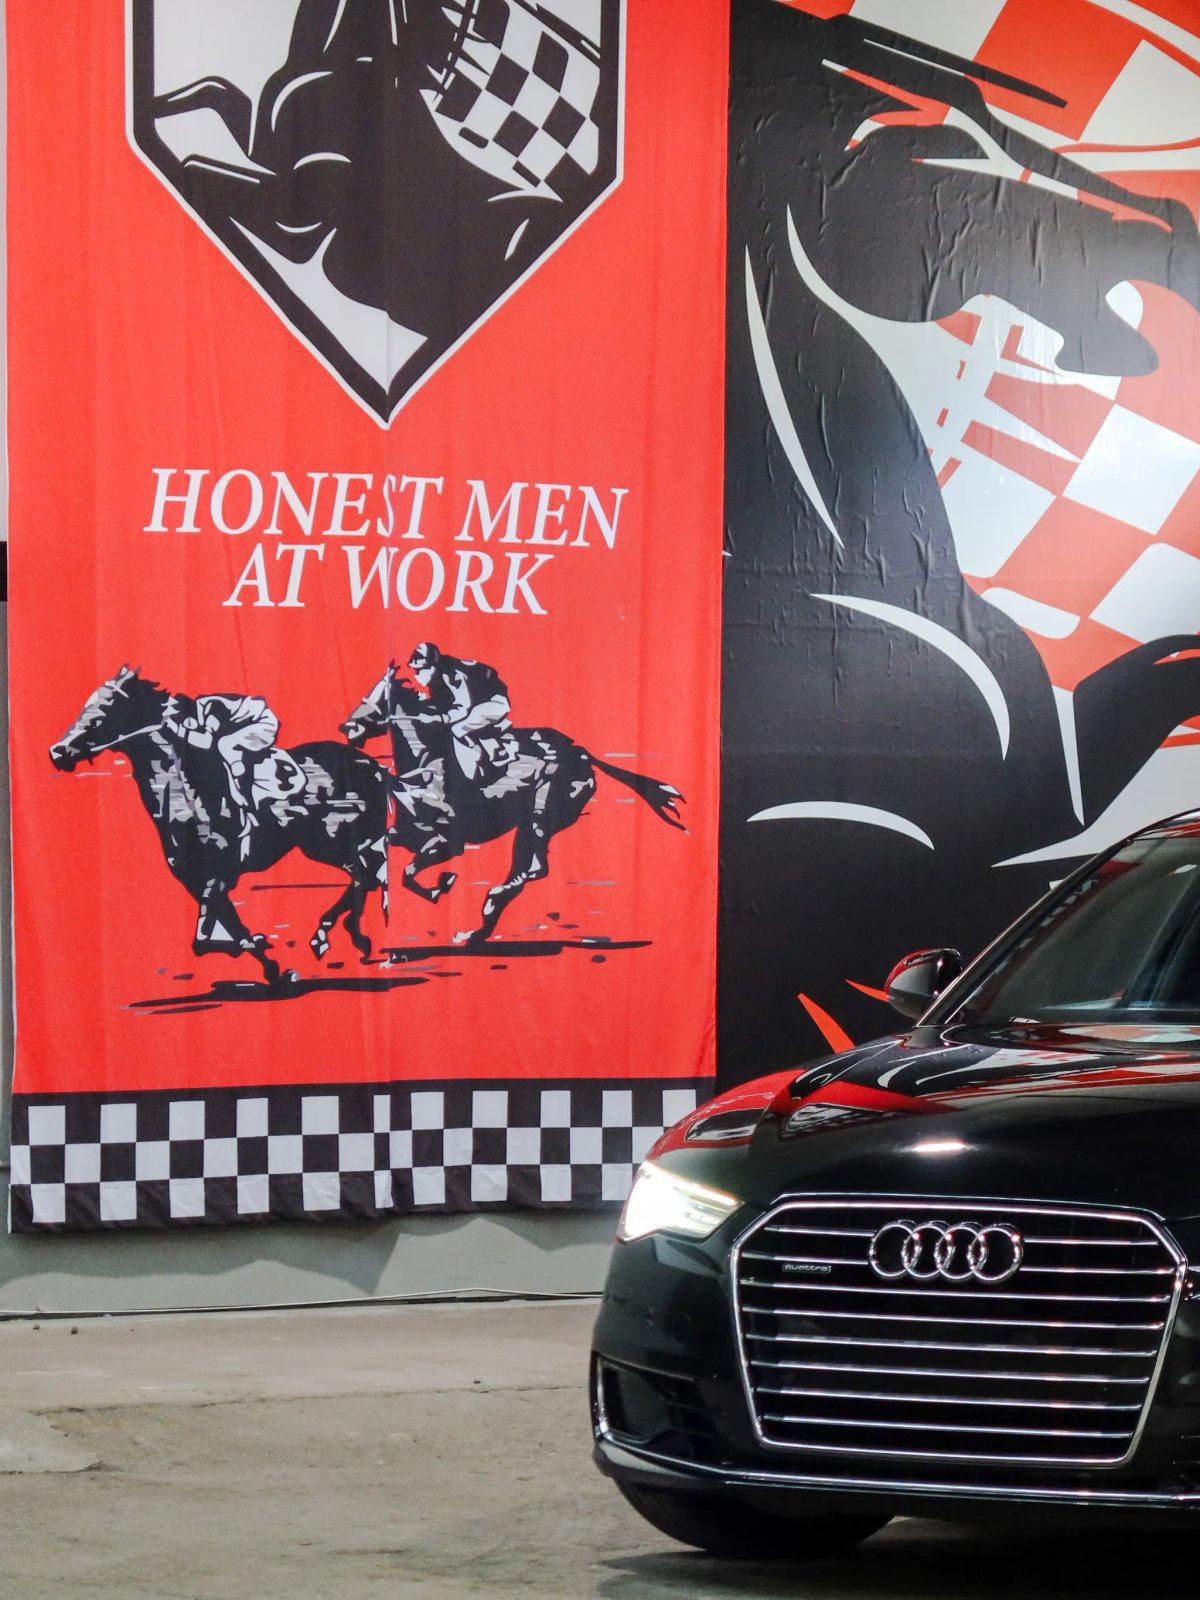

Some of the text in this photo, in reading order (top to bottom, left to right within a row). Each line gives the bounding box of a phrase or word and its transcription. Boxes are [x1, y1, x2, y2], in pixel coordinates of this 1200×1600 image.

[143, 467, 630, 549] HONEST MEN
[222, 542, 555, 615] AT WORK
